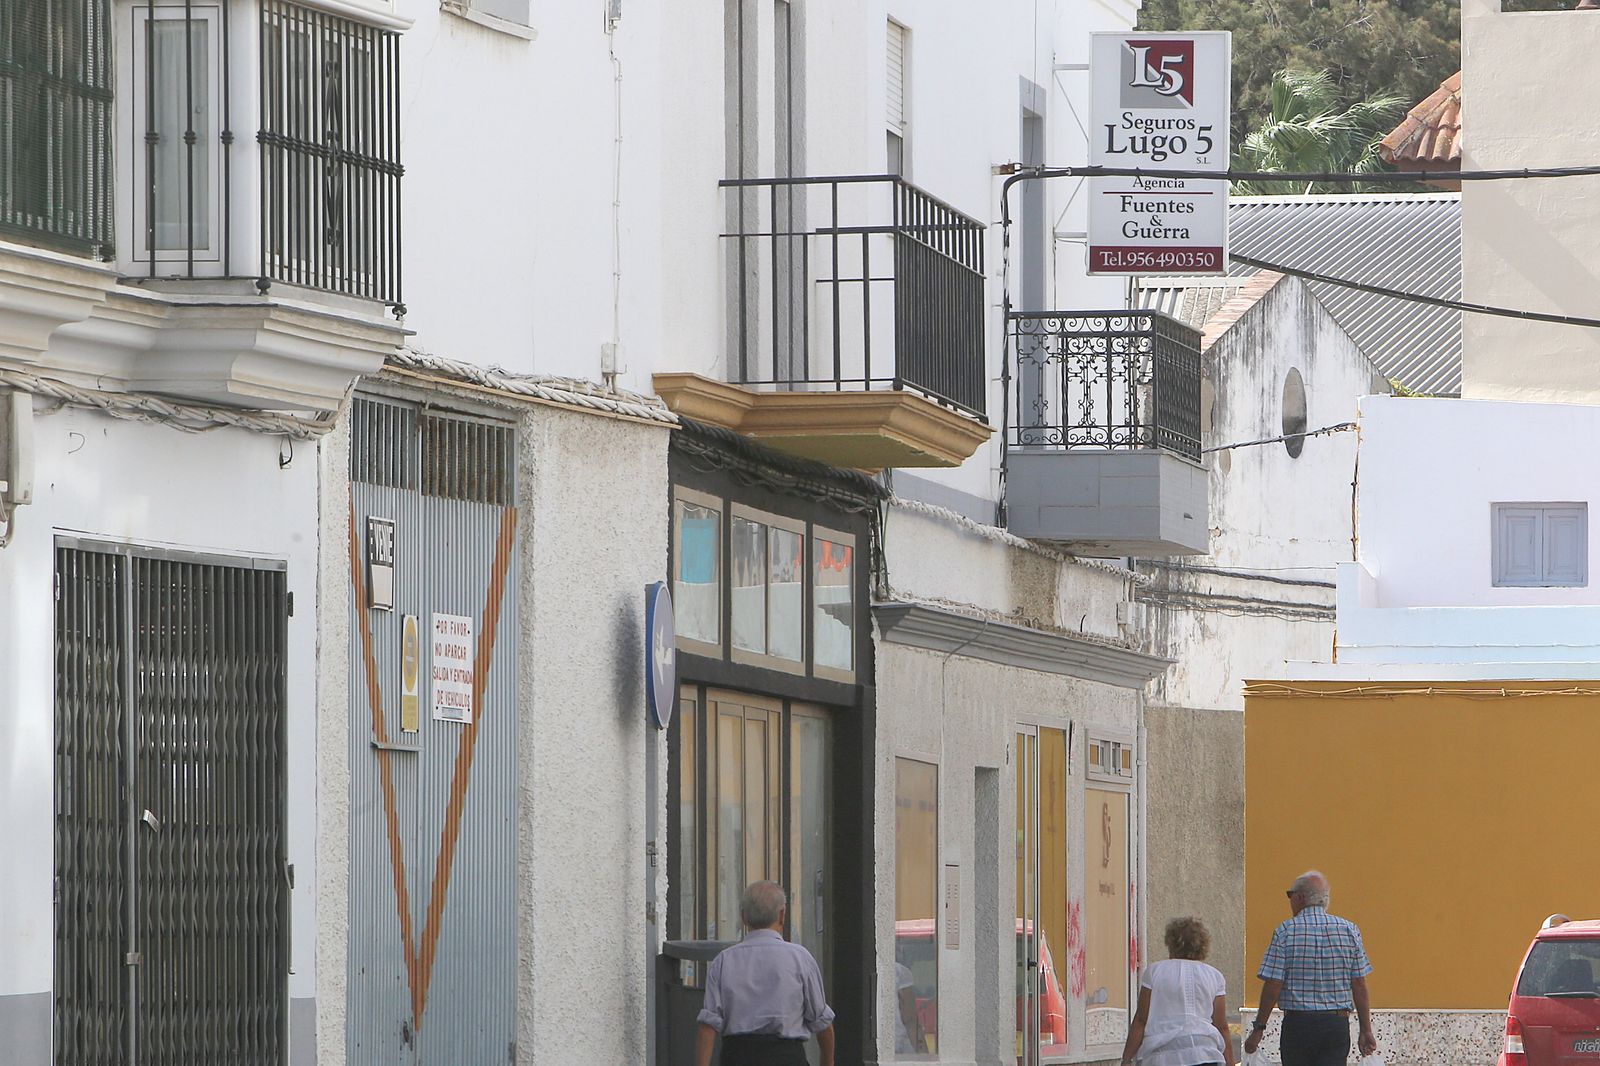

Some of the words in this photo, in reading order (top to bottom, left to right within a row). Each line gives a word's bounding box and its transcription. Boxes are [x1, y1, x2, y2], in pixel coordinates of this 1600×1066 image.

[1121, 111, 1196, 135] Seguros
[1103, 124, 1188, 163] Lugo
[1194, 124, 1214, 155] 5
[1132, 173, 1185, 191] Agencia
[1120, 195, 1195, 214] Fuentes
[1121, 220, 1191, 239] Guerra
[1149, 214, 1163, 227] &
[437, 619, 447, 635] POR
[450, 621, 467, 637] FAVOR
[435, 642, 442, 657] NO
[445, 643, 467, 660] APARCAR
[432, 665, 449, 681] SALIDA
[437, 689, 444, 704] DE
